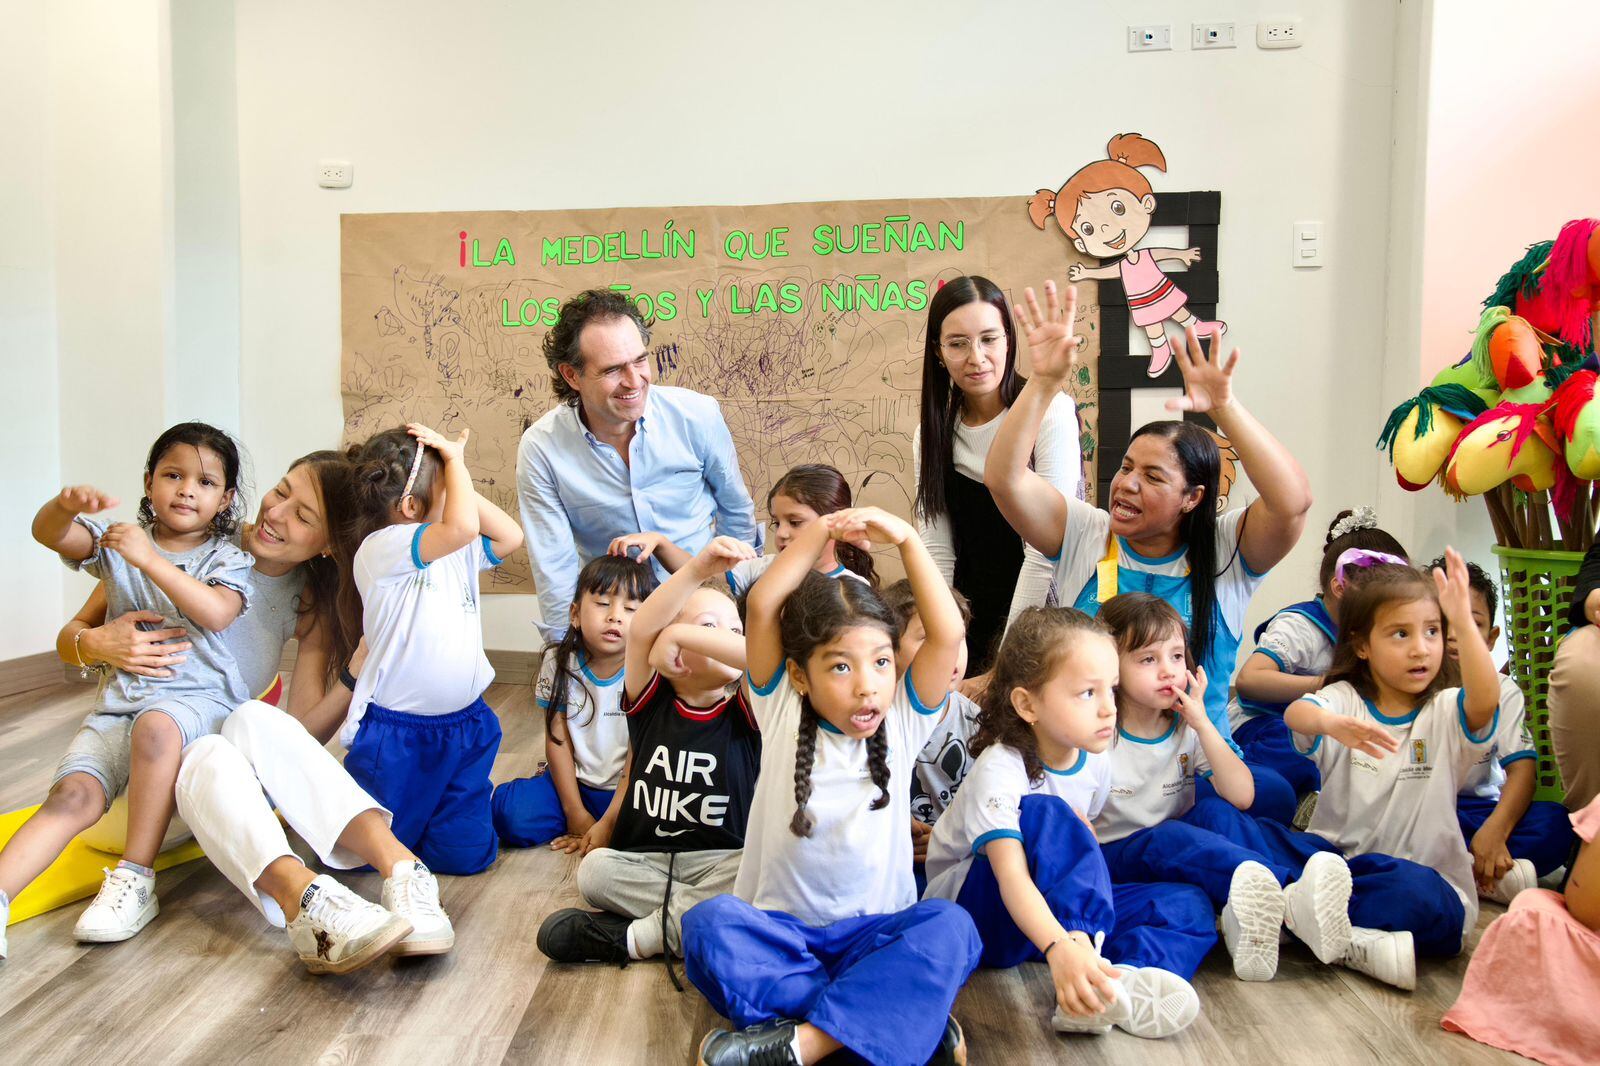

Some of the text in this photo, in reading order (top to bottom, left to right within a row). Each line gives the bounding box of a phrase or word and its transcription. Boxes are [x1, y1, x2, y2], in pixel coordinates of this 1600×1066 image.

[541, 219, 696, 266] MEDELLÍN
[724, 226, 790, 261] QUE
[812, 214, 965, 256] SUEÑAN
[502, 297, 562, 328] LOS
[696, 288, 715, 318] Y
[731, 282, 804, 315] LAS
[644, 744, 718, 787] AIR
[633, 779, 731, 827] NIKE
